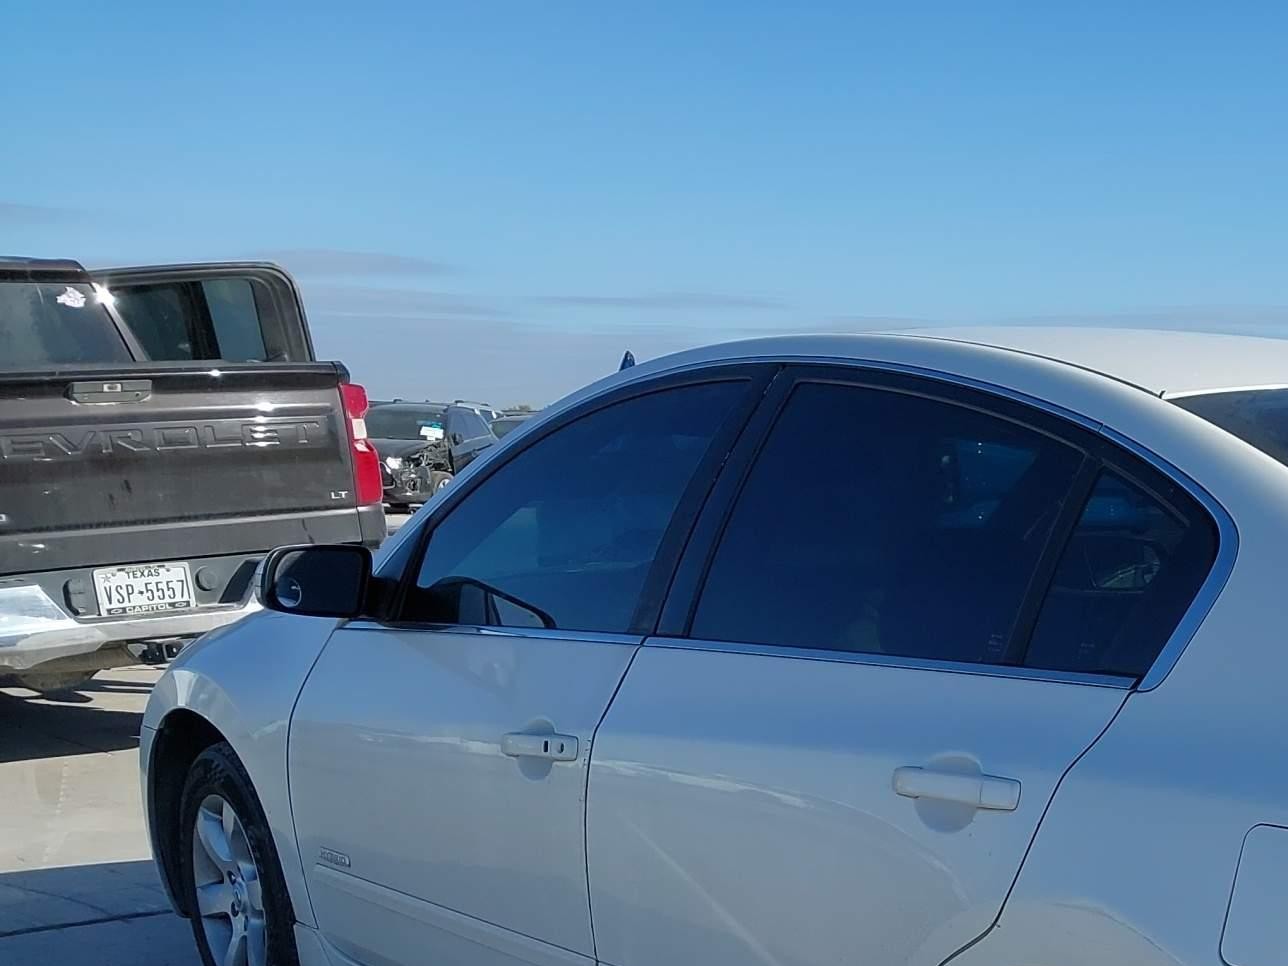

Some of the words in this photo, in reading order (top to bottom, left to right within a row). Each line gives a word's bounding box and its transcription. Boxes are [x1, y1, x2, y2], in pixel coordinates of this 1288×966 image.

[330, 490, 349, 500] LT
[125, 568, 161, 580] TEXAS
[125, 602, 174, 614] CAPITOL
